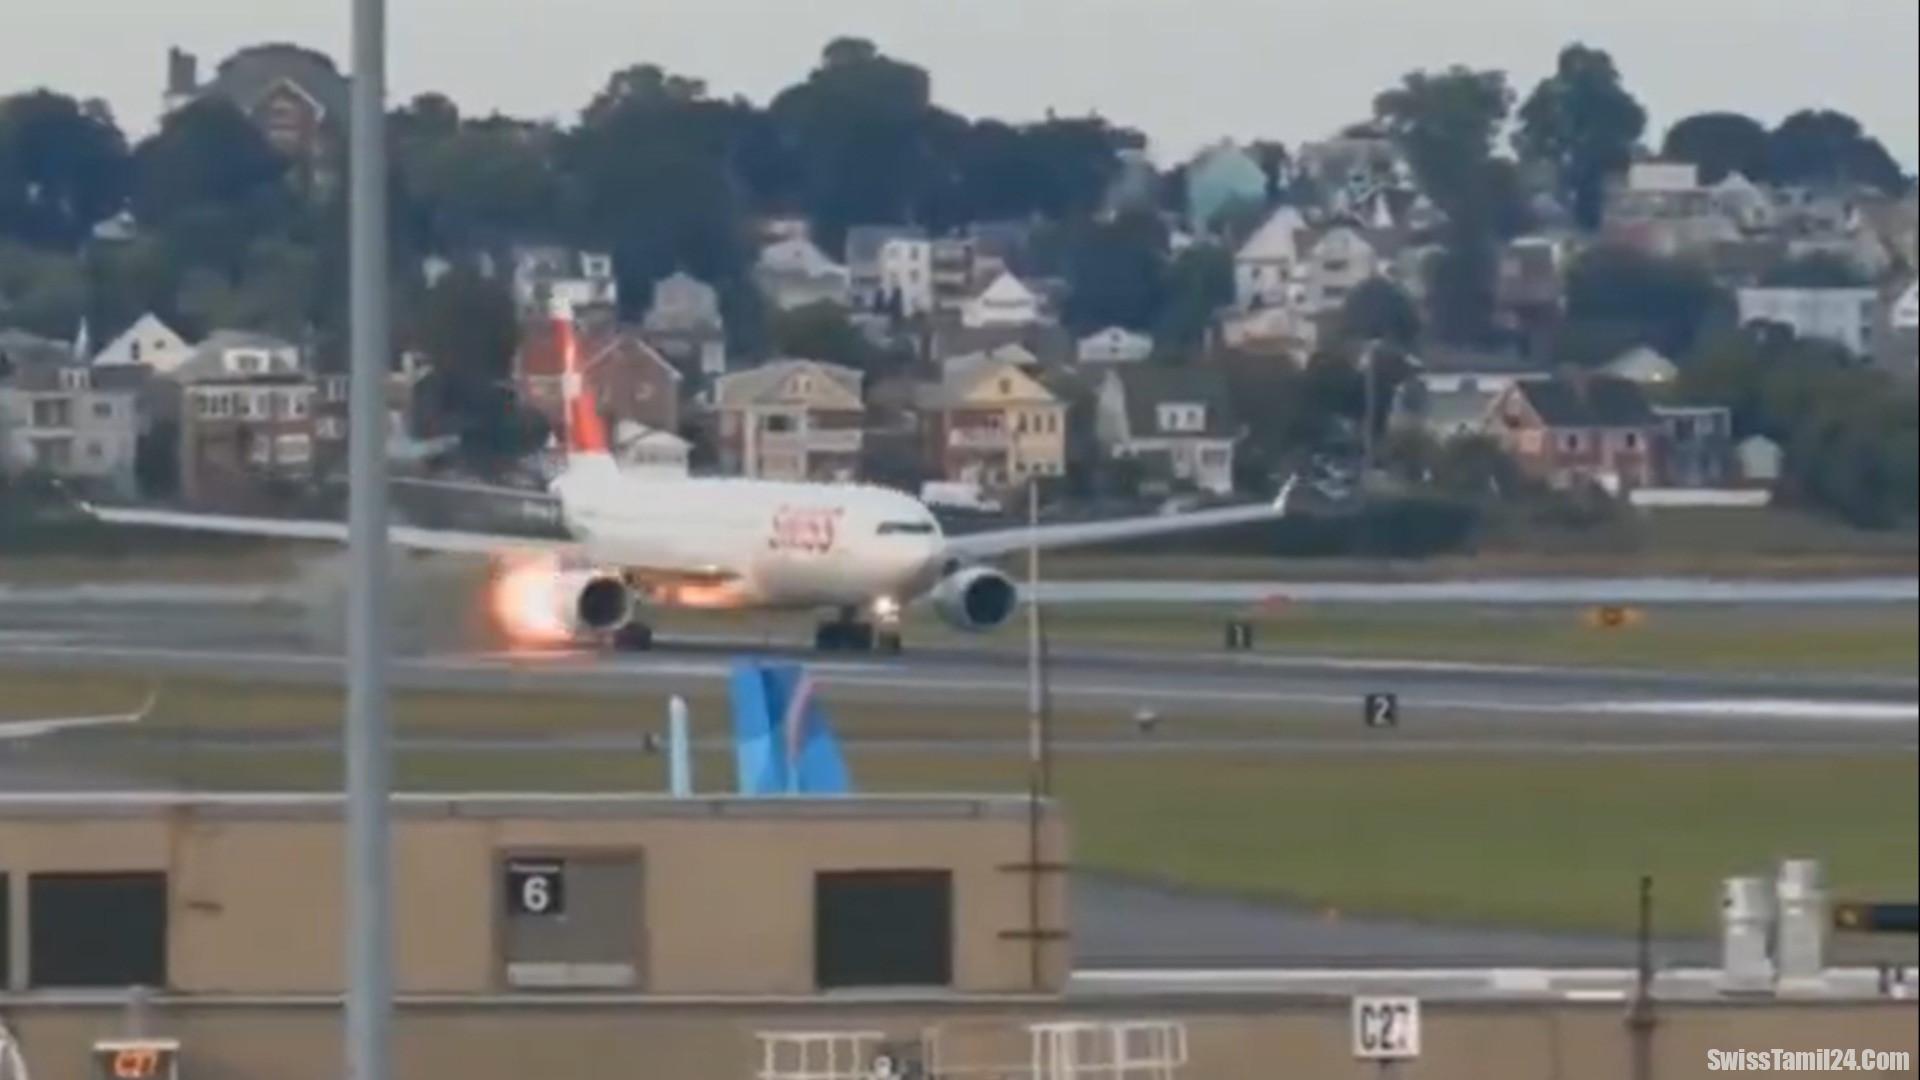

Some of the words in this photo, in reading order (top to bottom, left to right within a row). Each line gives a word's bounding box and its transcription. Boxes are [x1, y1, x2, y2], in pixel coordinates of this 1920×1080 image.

[1373, 697, 1389, 723] 2
[523, 877, 548, 910] 6
[1361, 1004, 1408, 1050] C27
